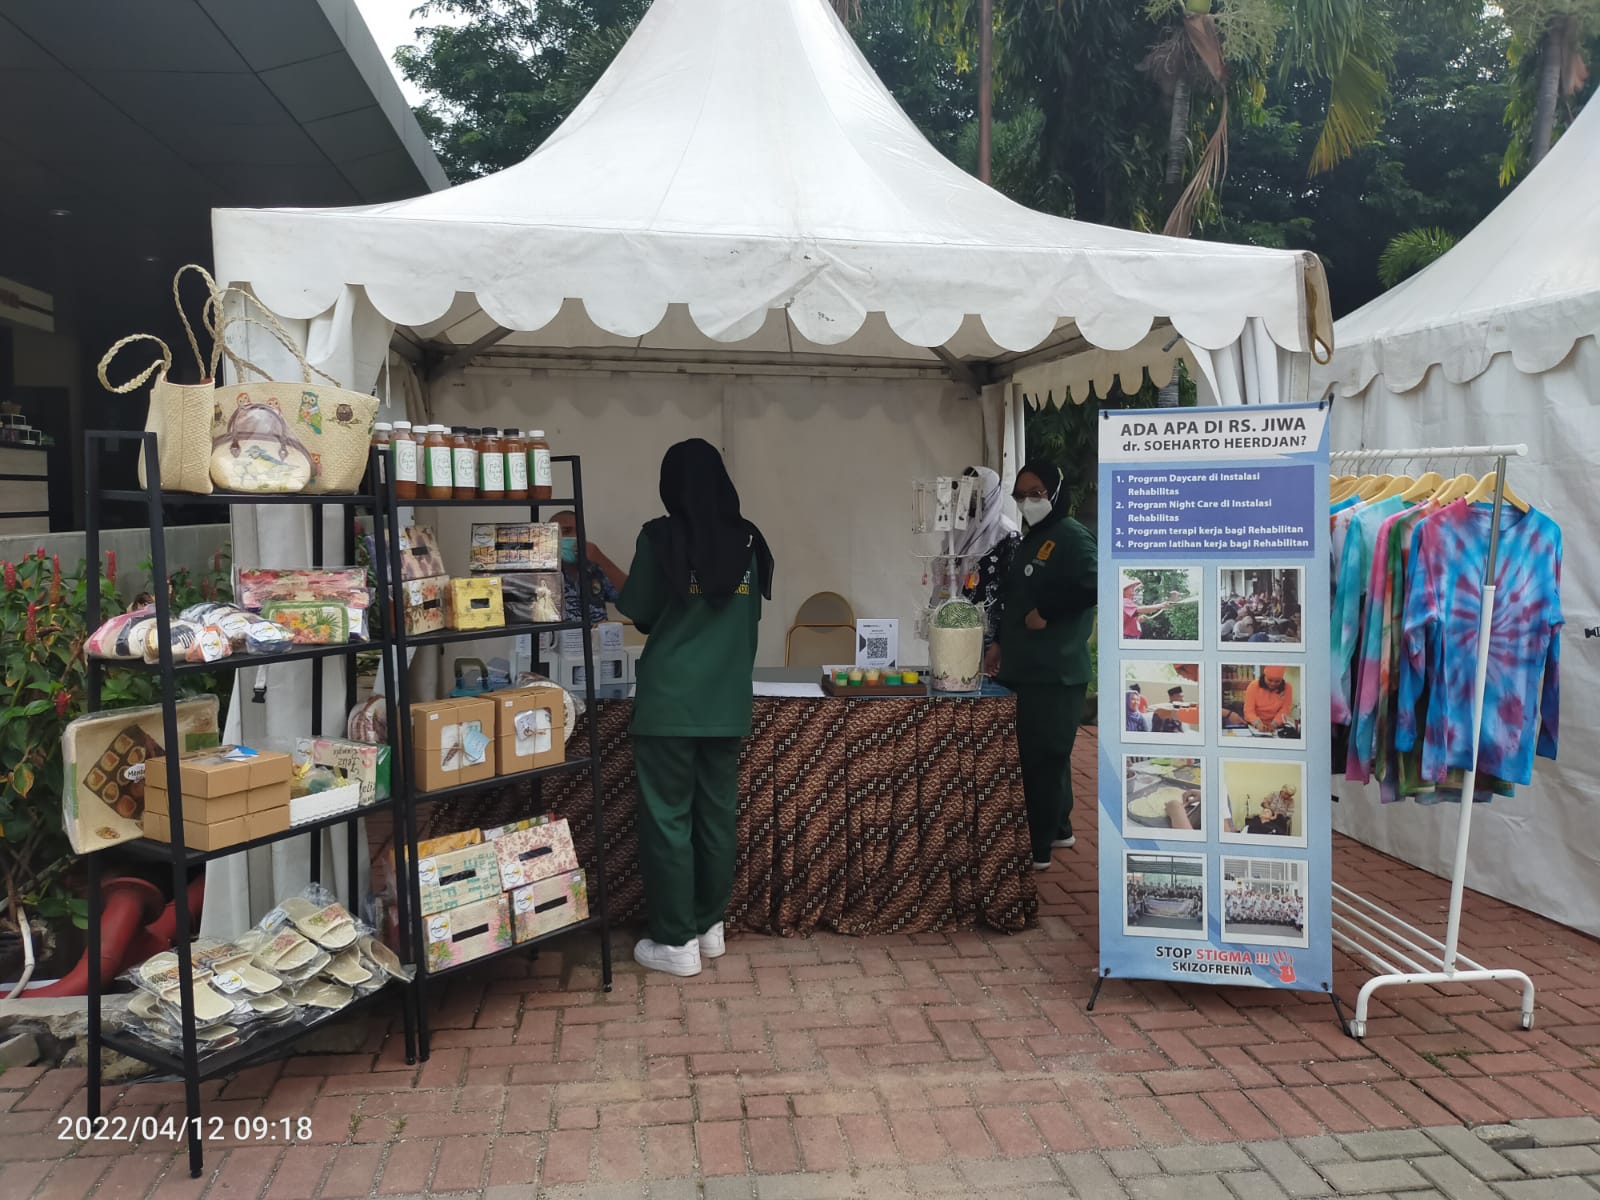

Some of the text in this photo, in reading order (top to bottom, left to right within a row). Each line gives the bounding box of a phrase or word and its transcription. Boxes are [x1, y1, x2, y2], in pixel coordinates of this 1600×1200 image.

[1121, 418, 1305, 436] ADA APA DI RS. JIWA
[1123, 436, 1306, 452] dr. SOEHARTO HEERDJAN?
[1128, 475, 1167, 484] Program
[1170, 474, 1206, 482] Daycare
[1220, 472, 1260, 480] Instalasi
[1128, 501, 1167, 510] Program
[1170, 500, 1195, 510] Night
[1128, 527, 1167, 537] Program
[1169, 527, 1196, 536] terapi
[1199, 526, 1222, 536] kerja
[1225, 526, 1246, 535] bagi
[1248, 526, 1303, 534] Rehabilitan
[1128, 540, 1166, 550] Program
[1204, 540, 1227, 549] kerja
[1230, 540, 1251, 548] bagi
[1254, 539, 1308, 547] Rehabilitan
[1156, 946, 1269, 963] STOP STIGMA !!!
[1172, 962, 1252, 976] SKIZOFRENIA
